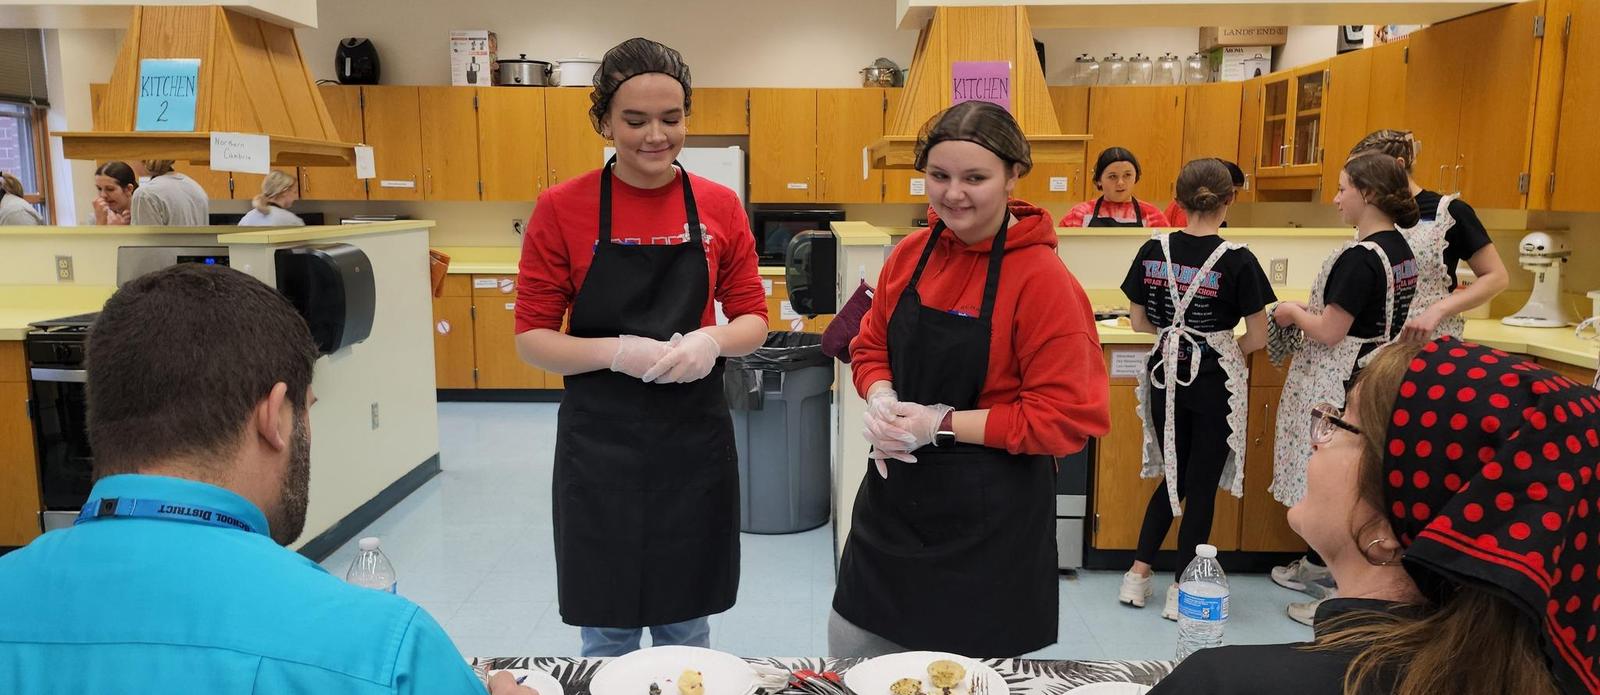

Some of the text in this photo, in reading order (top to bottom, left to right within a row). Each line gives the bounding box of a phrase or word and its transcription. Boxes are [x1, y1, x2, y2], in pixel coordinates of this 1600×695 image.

[1256, 28, 1276, 36] END
[140, 75, 195, 98] KITCHEN
[953, 77, 1009, 100] KITCHEN
[156, 100, 170, 122] 2
[1142, 260, 1222, 290] YEARBOK
[1197, 287, 1218, 297] CHOOL
[158, 503, 251, 532] SCHOOL DISTRICT
